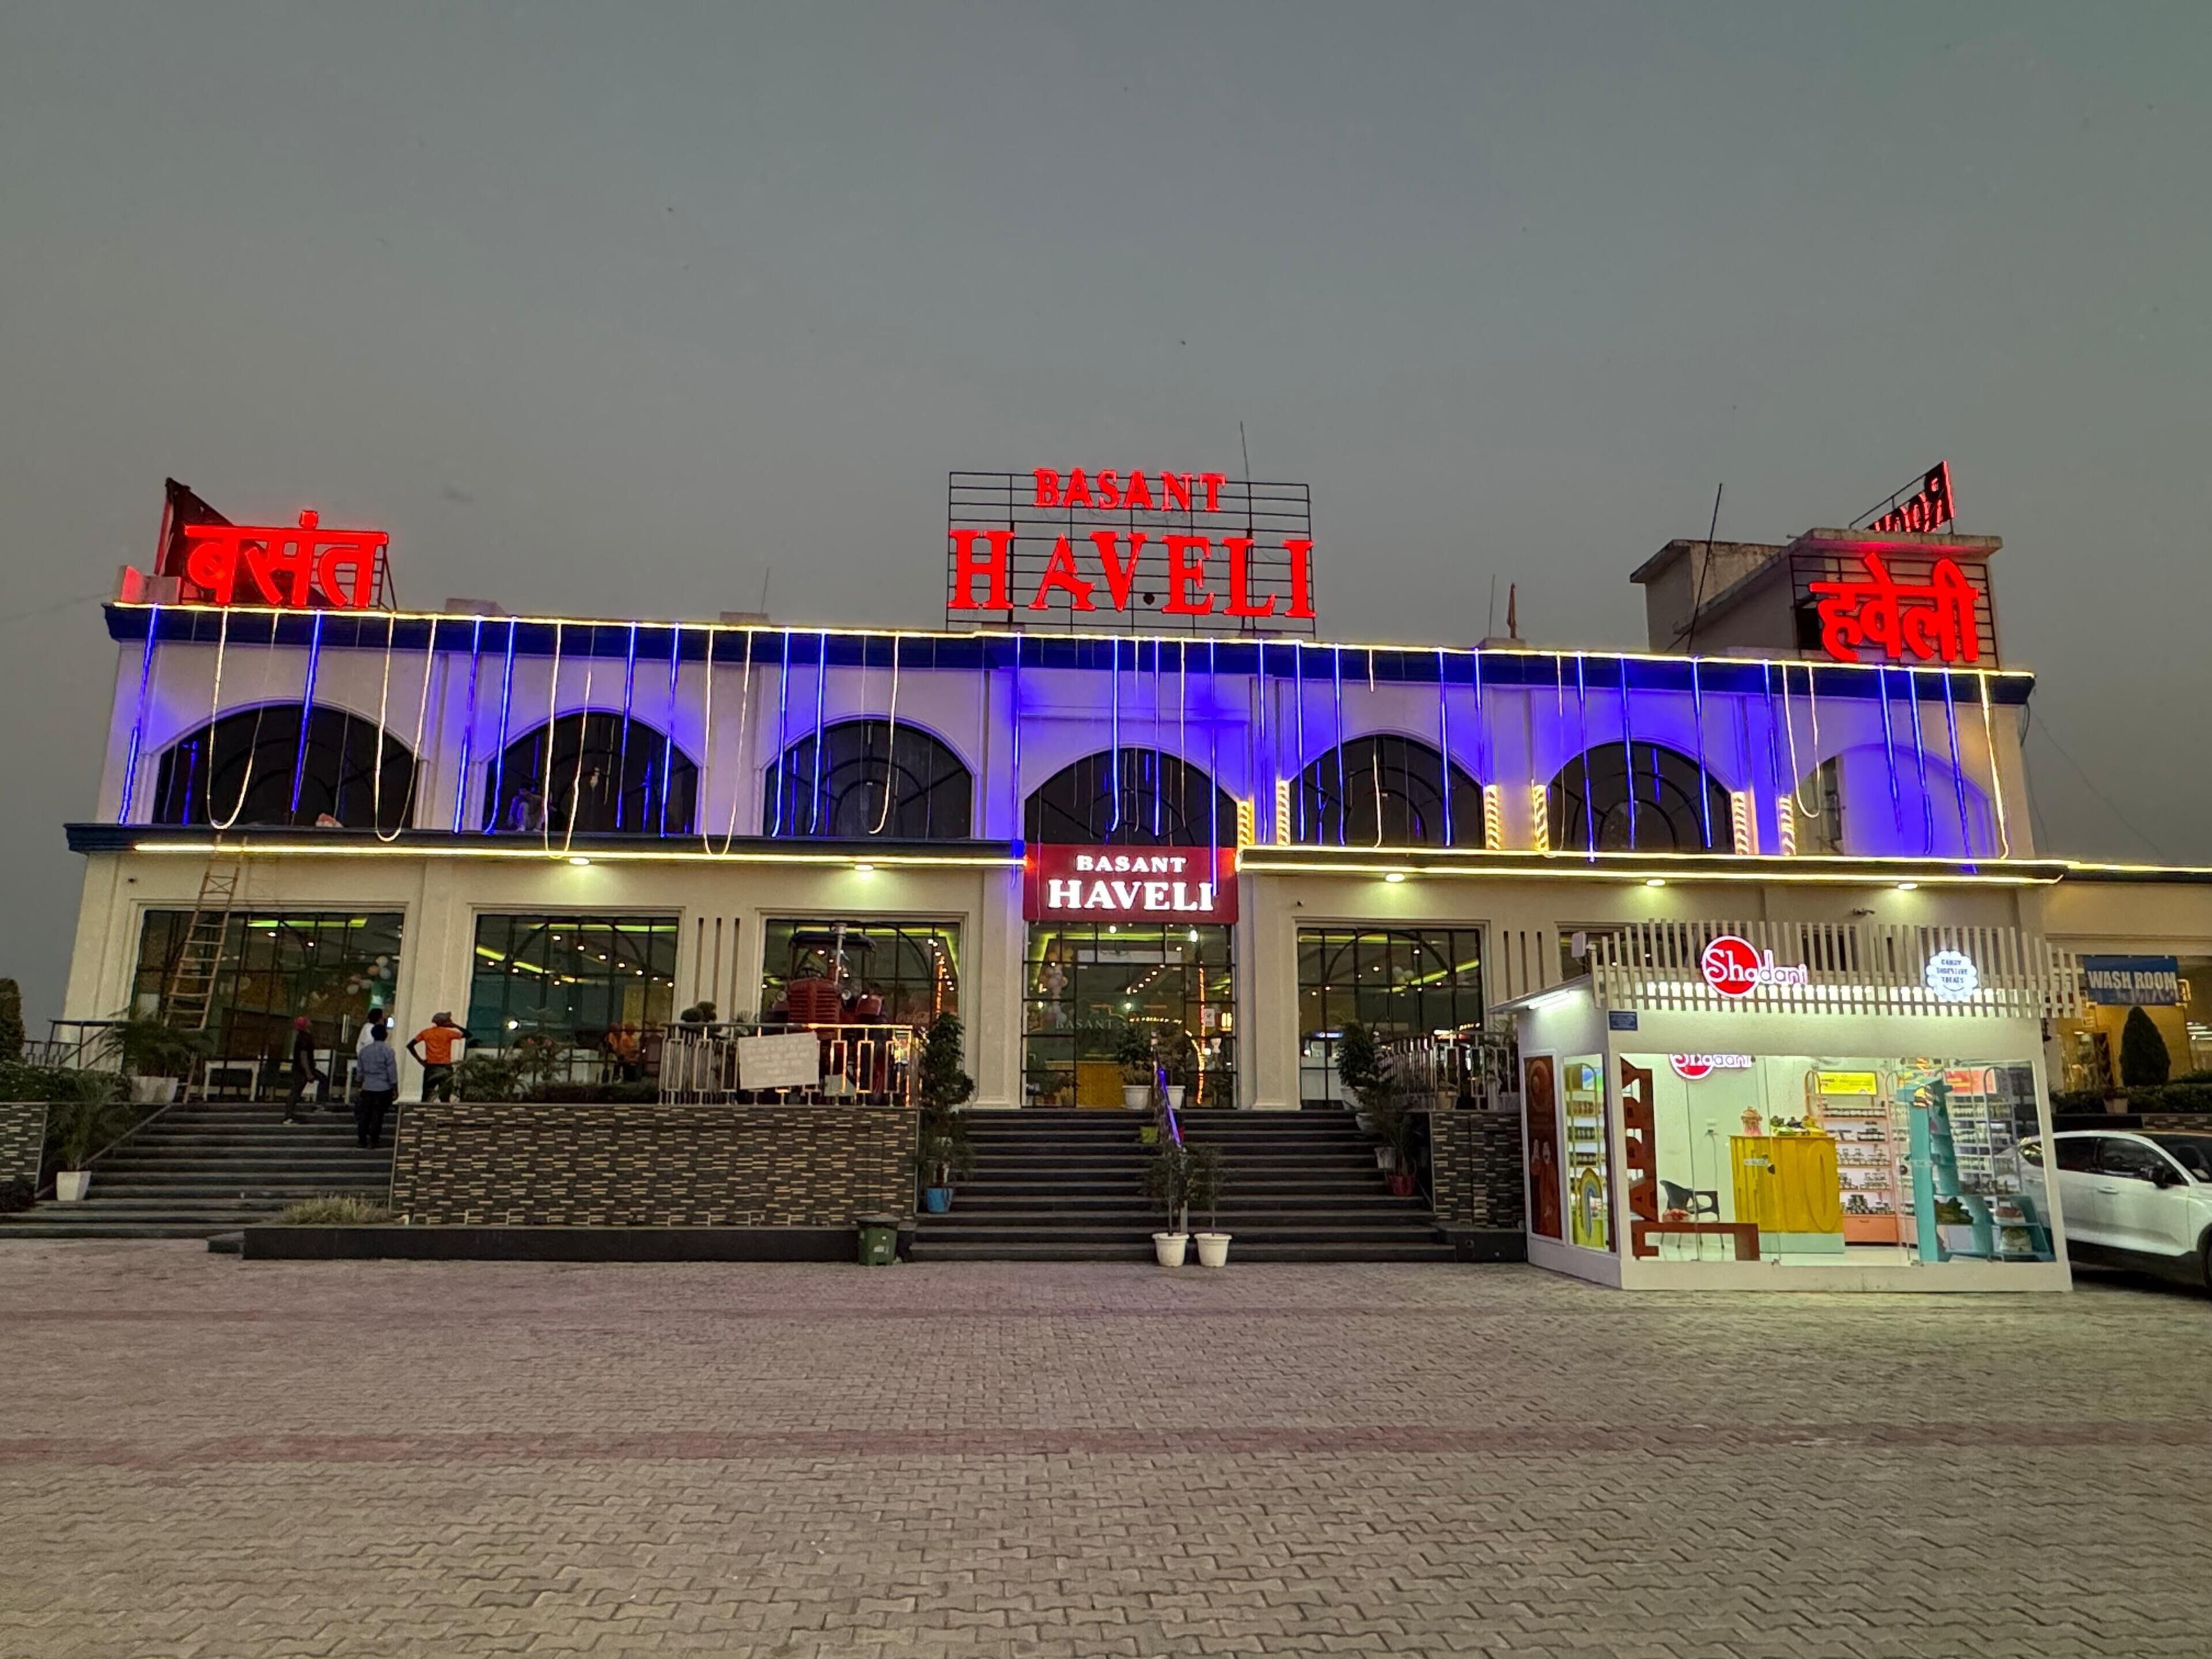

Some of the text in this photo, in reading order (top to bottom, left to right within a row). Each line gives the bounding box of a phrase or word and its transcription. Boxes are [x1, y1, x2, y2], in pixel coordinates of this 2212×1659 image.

[1033, 467, 1226, 512] BASANT
[184, 510, 389, 608] बसंत
[948, 529, 1316, 618] HAVELI
[1809, 553, 1979, 662] हवेली
[1076, 855, 1187, 873] BASANT
[1047, 879, 1214, 911] HAVELI
[1704, 948, 1809, 984] Shadani
[2088, 970, 2177, 991] WASH ROOM
